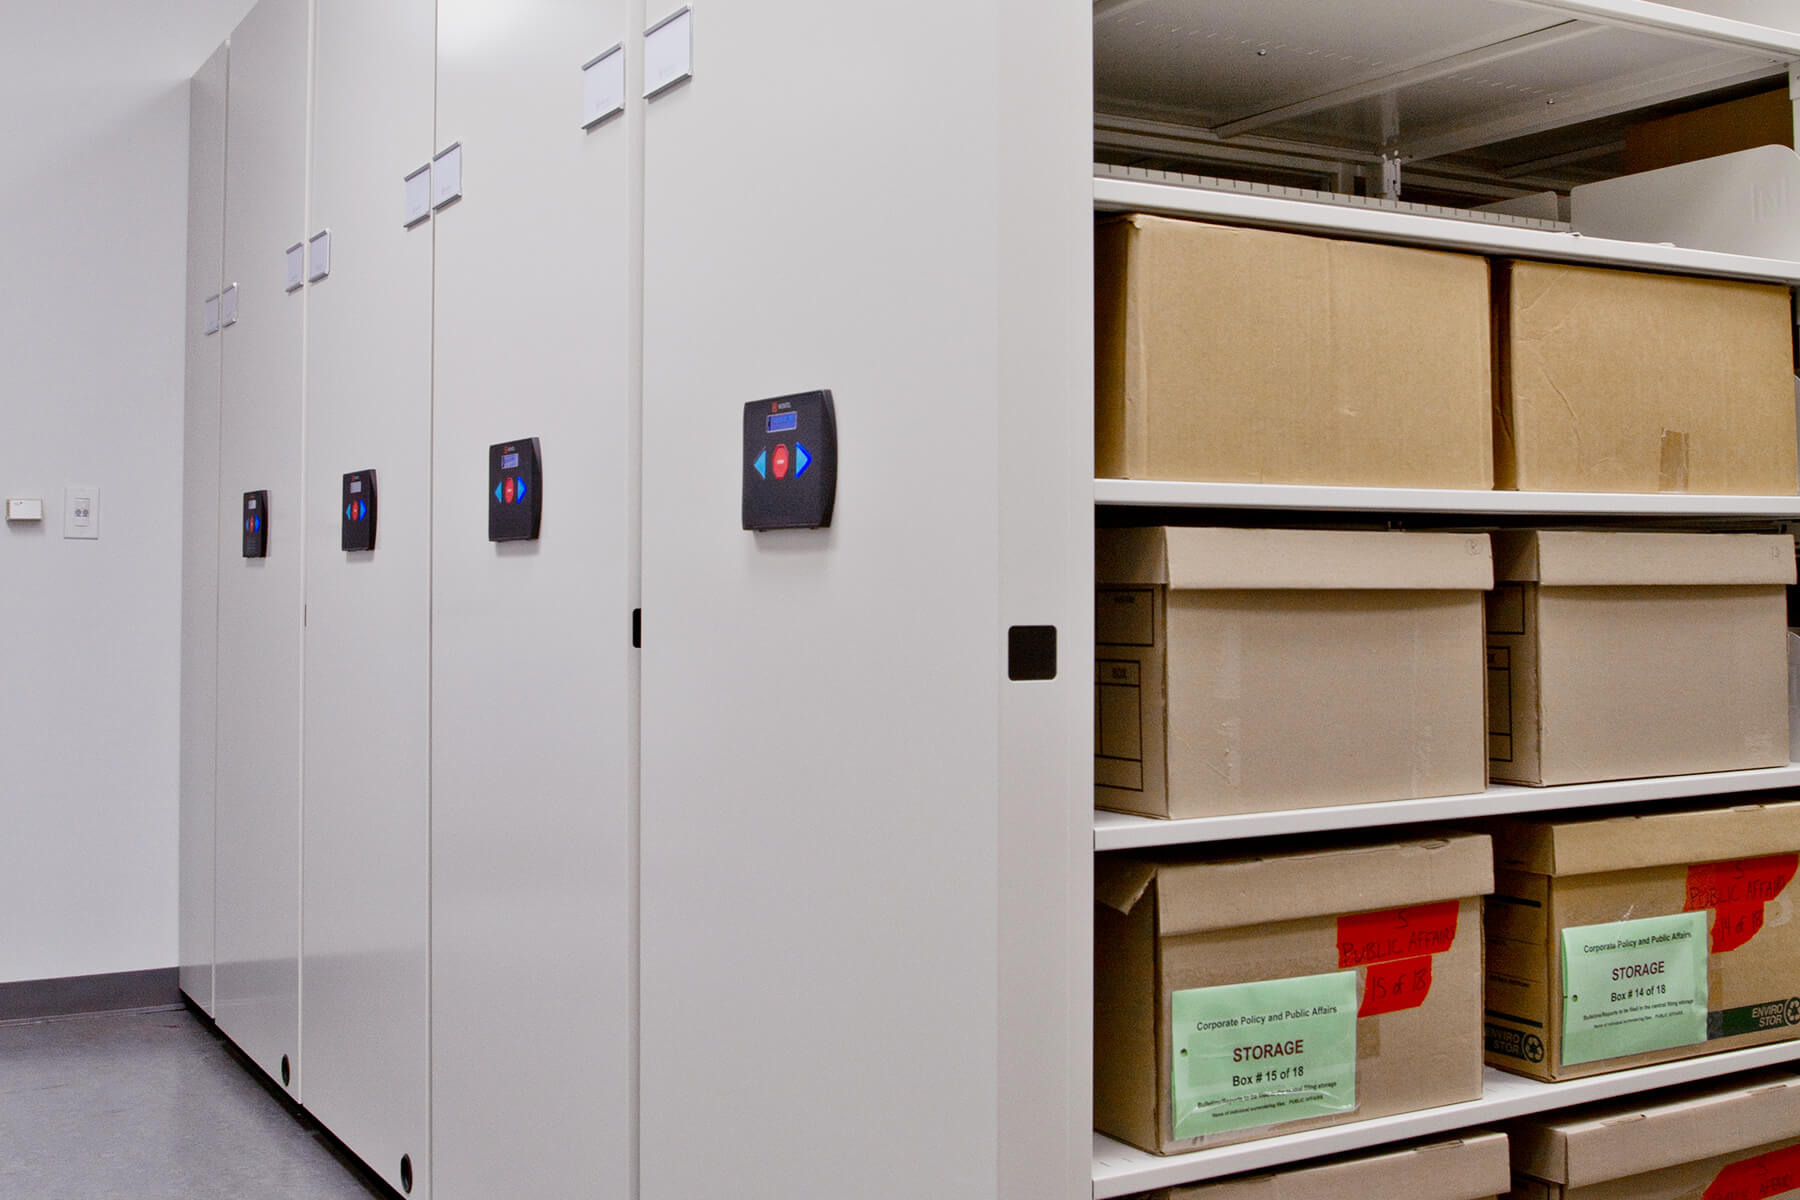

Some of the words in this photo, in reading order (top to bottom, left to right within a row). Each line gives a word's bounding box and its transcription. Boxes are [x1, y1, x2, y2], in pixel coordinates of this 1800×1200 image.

[1342, 938, 1403, 963] PUBLIC
[1408, 925, 1455, 951] AFFAIRS
[1584, 943, 1616, 953] Corporate
[1617, 940, 1637, 949] Policy
[1638, 937, 1650, 946] and
[1651, 934, 1670, 944] Public
[1672, 932, 1692, 940] Affairs
[1612, 961, 1664, 981] STORAGE
[1372, 975, 1386, 1001] 15
[1393, 974, 1407, 994] of
[1413, 968, 1427, 992] 18
[1611, 992, 1626, 1002] Box
[1628, 990, 1633, 999] #
[1635, 988, 1644, 997] 14
[1646, 986, 1655, 996] of
[1656, 984, 1666, 994] 18
[1197, 1019, 1238, 1031] Corporate
[1240, 1015, 1266, 1025] Policy
[1268, 1013, 1283, 1022] and
[1285, 1009, 1309, 1019] Public
[1312, 1005, 1337, 1016] Affairs
[1752, 1003, 1784, 1018] ENVIRO
[1759, 1015, 1782, 1028] STOR
[1233, 1040, 1304, 1062] STORAGE
[1232, 1075, 1253, 1087] Box
[1255, 1072, 1263, 1083] #
[1265, 1070, 1277, 1081] 15
[1280, 1068, 1290, 1079] of
[1293, 1066, 1304, 1077] 18
